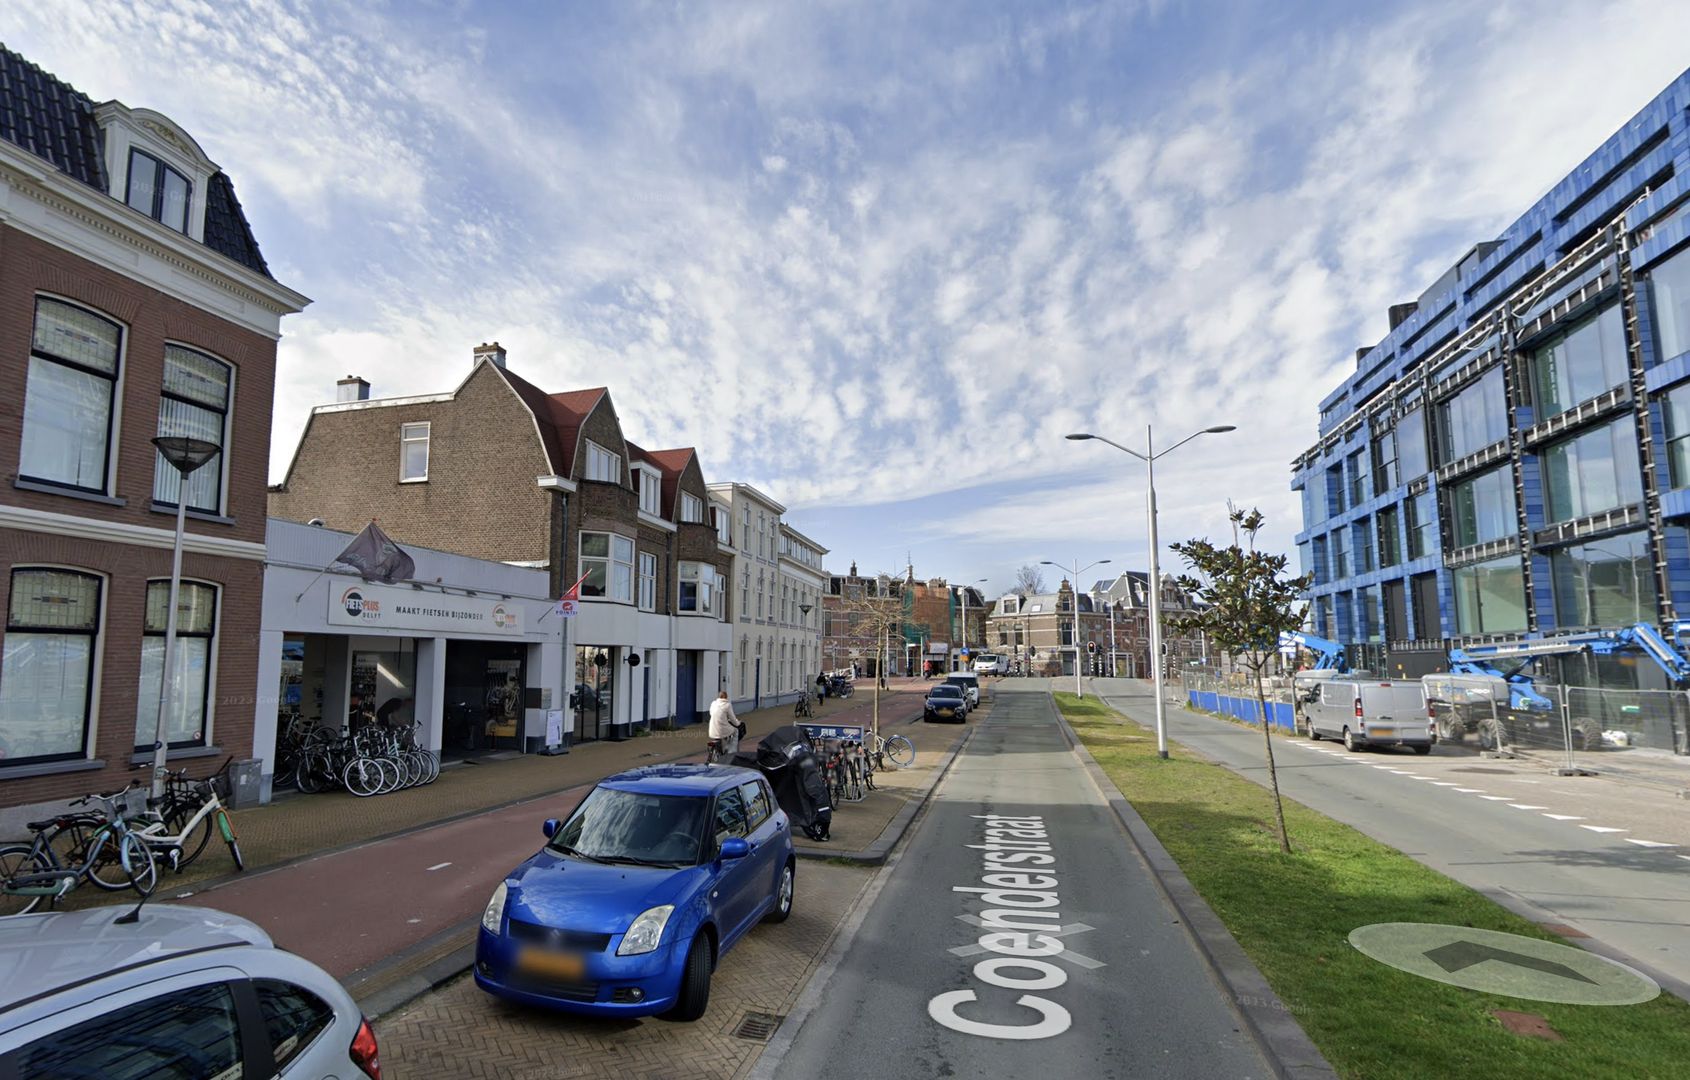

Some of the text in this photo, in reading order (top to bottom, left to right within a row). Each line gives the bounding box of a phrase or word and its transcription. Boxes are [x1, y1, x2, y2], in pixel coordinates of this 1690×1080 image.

[395, 606, 484, 620] MAAKT FIETSEN BIJZONDER
